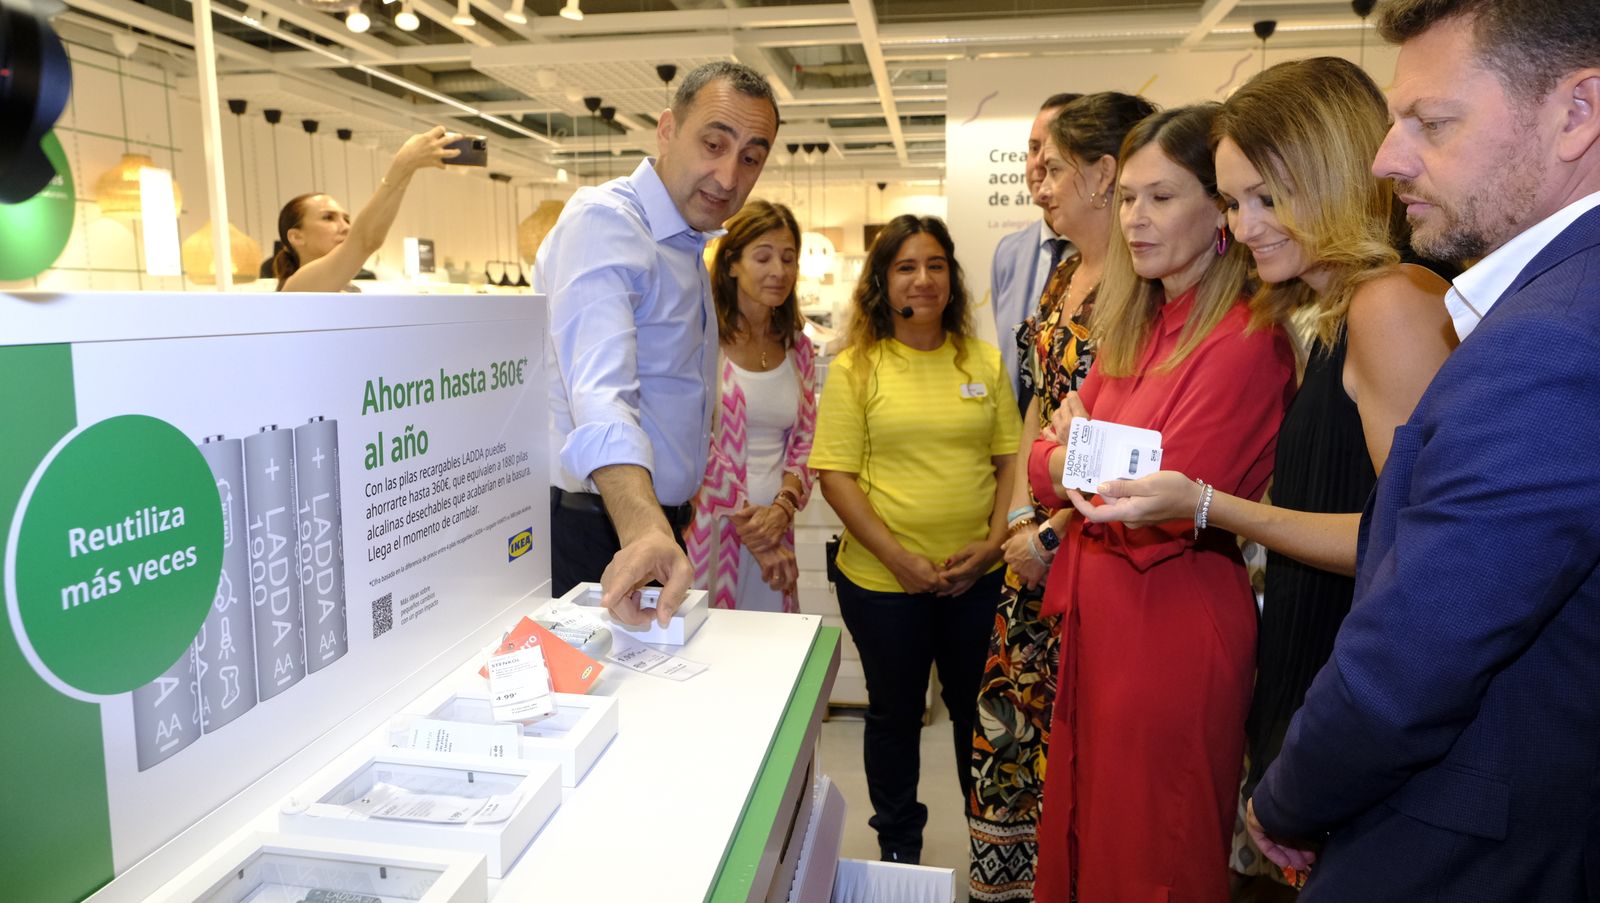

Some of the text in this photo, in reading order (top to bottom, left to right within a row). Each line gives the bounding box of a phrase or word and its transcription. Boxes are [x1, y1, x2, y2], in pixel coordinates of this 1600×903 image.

[988, 191, 1010, 206] de
[361, 377, 435, 416] Ahorra
[440, 368, 486, 400] hasta
[364, 424, 429, 470] al año
[365, 442, 507, 498] Con las pilas recargables LADDA puedes
[1066, 449, 1076, 476] LADDA
[1071, 430, 1079, 447] AAA
[366, 494, 407, 520] ahorrarte
[409, 486, 430, 503] hasta
[431, 478, 451, 497] 360€,
[452, 477, 465, 492] que
[466, 462, 497, 485] equivalen
[502, 457, 516, 470] 1880
[516, 450, 529, 467] pilas
[367, 466, 532, 541] alcalinas desechables que acabarían en la basura.
[68, 505, 186, 558] Reutiliza
[300, 499, 314, 585] 1900
[368, 542, 392, 562] Llega
[393, 536, 401, 550] el
[403, 523, 440, 548] momento
[441, 516, 451, 531] de
[451, 504, 480, 529] cambiar.
[511, 535, 531, 554] IKEA
[61, 545, 198, 611] más veces
[250, 514, 268, 606] 1900
[265, 506, 292, 647] LADDA
[312, 492, 335, 625] LADDA
[381, 570, 395, 583] basada
[405, 557, 422, 572] diferencia
[422, 554, 427, 562] de
[274, 653, 294, 680] AA
[319, 630, 337, 653] AA
[156, 713, 183, 745] AA
